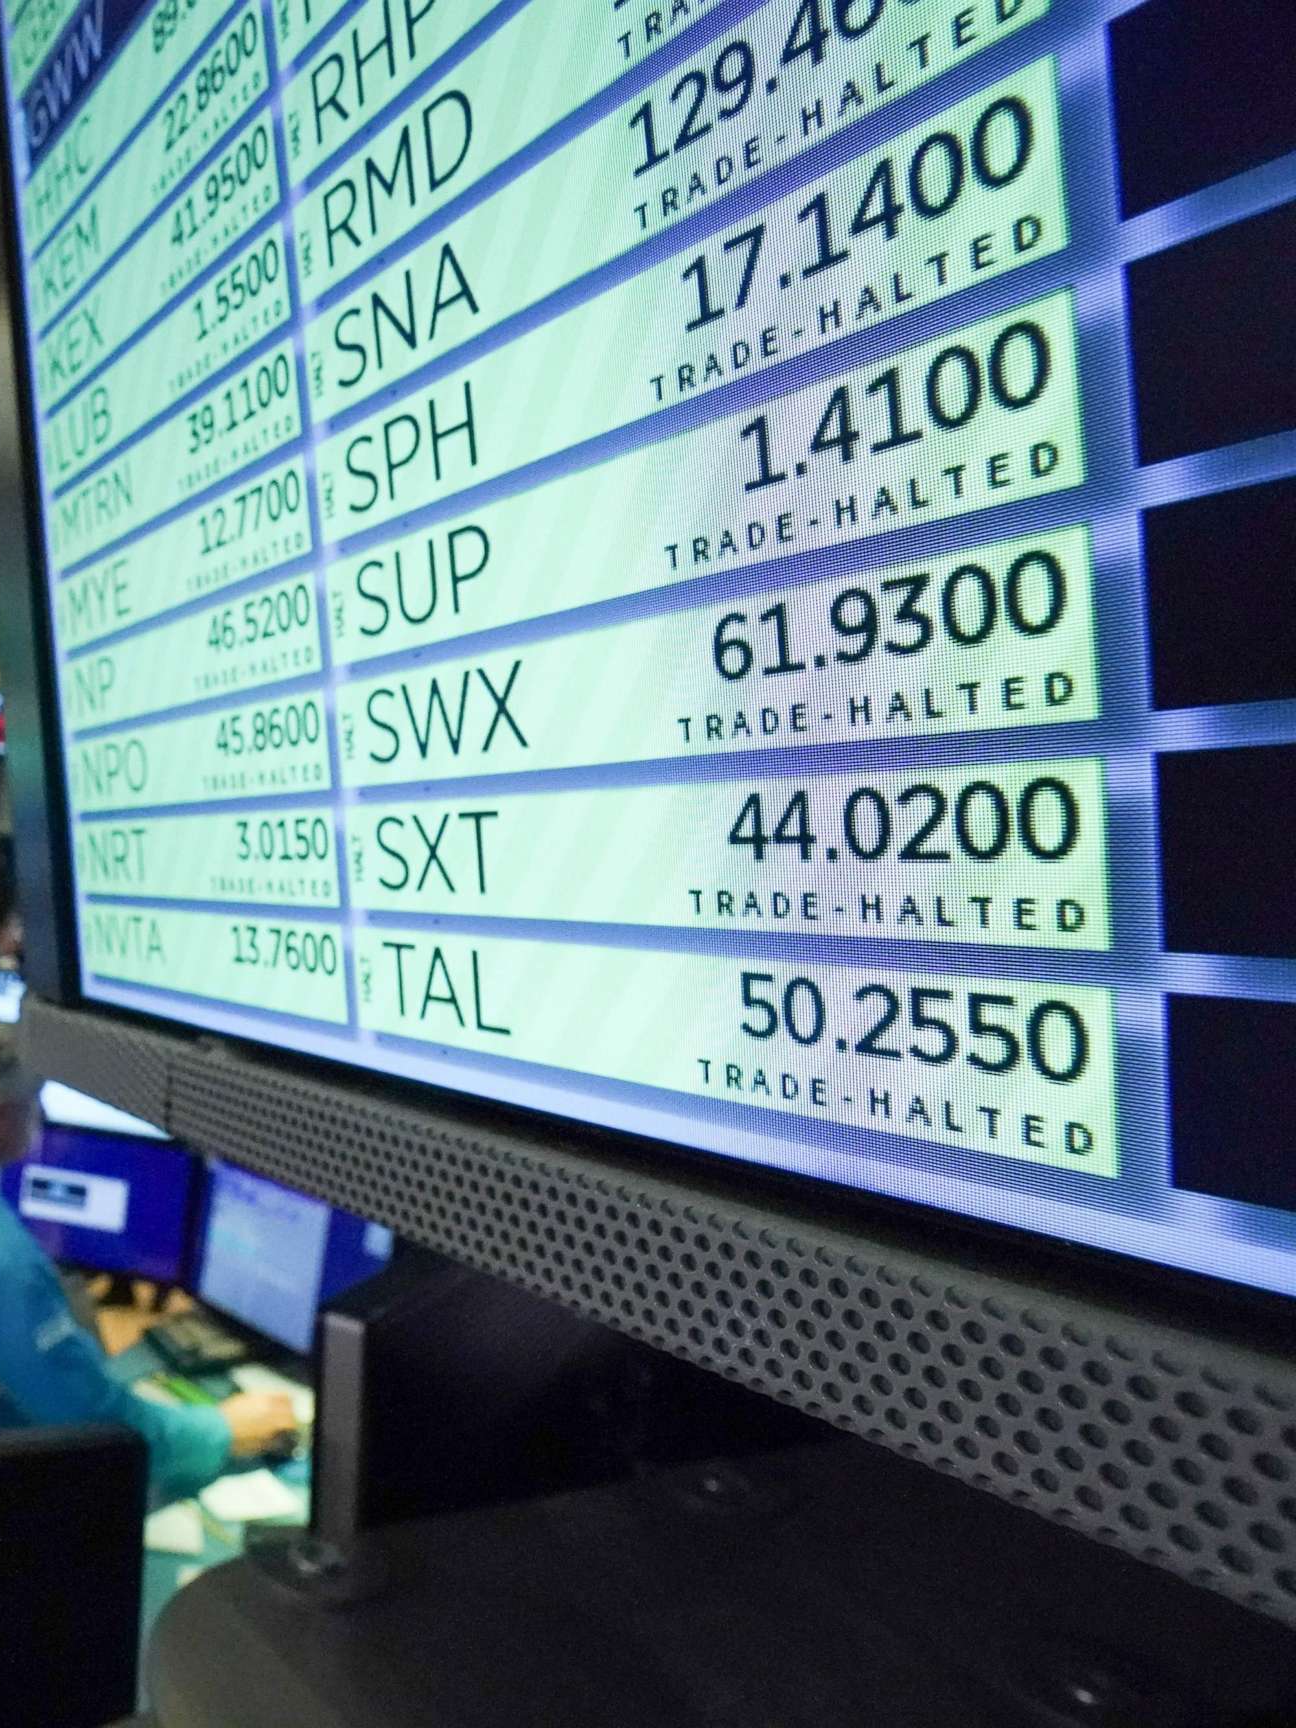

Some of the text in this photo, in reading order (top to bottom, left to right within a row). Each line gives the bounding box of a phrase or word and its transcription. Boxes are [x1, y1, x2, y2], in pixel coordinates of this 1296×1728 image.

[165, 12, 258, 152] 22.8600
[629, 0, 919, 178] 129.4
[170, 125, 268, 246] 41.9500
[323, 90, 472, 267] RMD
[681, 96, 1034, 332] 17.1400
[193, 239, 278, 342] 1.5500
[334, 243, 479, 388] SNA
[649, 215, 1042, 402] TRADE-HALTED
[48, 295, 104, 391] KEX
[56, 387, 112, 472] LUB
[187, 353, 290, 454] 39.1100
[346, 381, 477, 512] SPH
[741, 320, 1053, 491] 1.4100
[199, 469, 300, 556] 12.7700
[665, 441, 1059, 569] TRADE-HALTED
[67, 558, 131, 636] MYE
[208, 584, 310, 654] 46.5200
[357, 525, 490, 637] SUP
[713, 550, 1067, 683] 61.9300
[75, 656, 115, 718] NP
[215, 703, 321, 756] 45.8600
[367, 660, 528, 763] SWX
[678, 671, 1074, 743] TRADE-HALTED
[82, 739, 148, 798] NPO
[89, 829, 145, 882] NRT
[236, 817, 328, 860] 3.0150
[376, 811, 498, 894] SXT
[729, 777, 1081, 862] 44.0200
[94, 914, 166, 964] NVTA
[232, 924, 337, 977] 13.7600
[688, 890, 1085, 932] TRADE-HALTED
[383, 942, 511, 1036] TAL
[740, 972, 1090, 1084] 50.2550
[698, 1059, 1094, 1155] TRADE-HALTED
